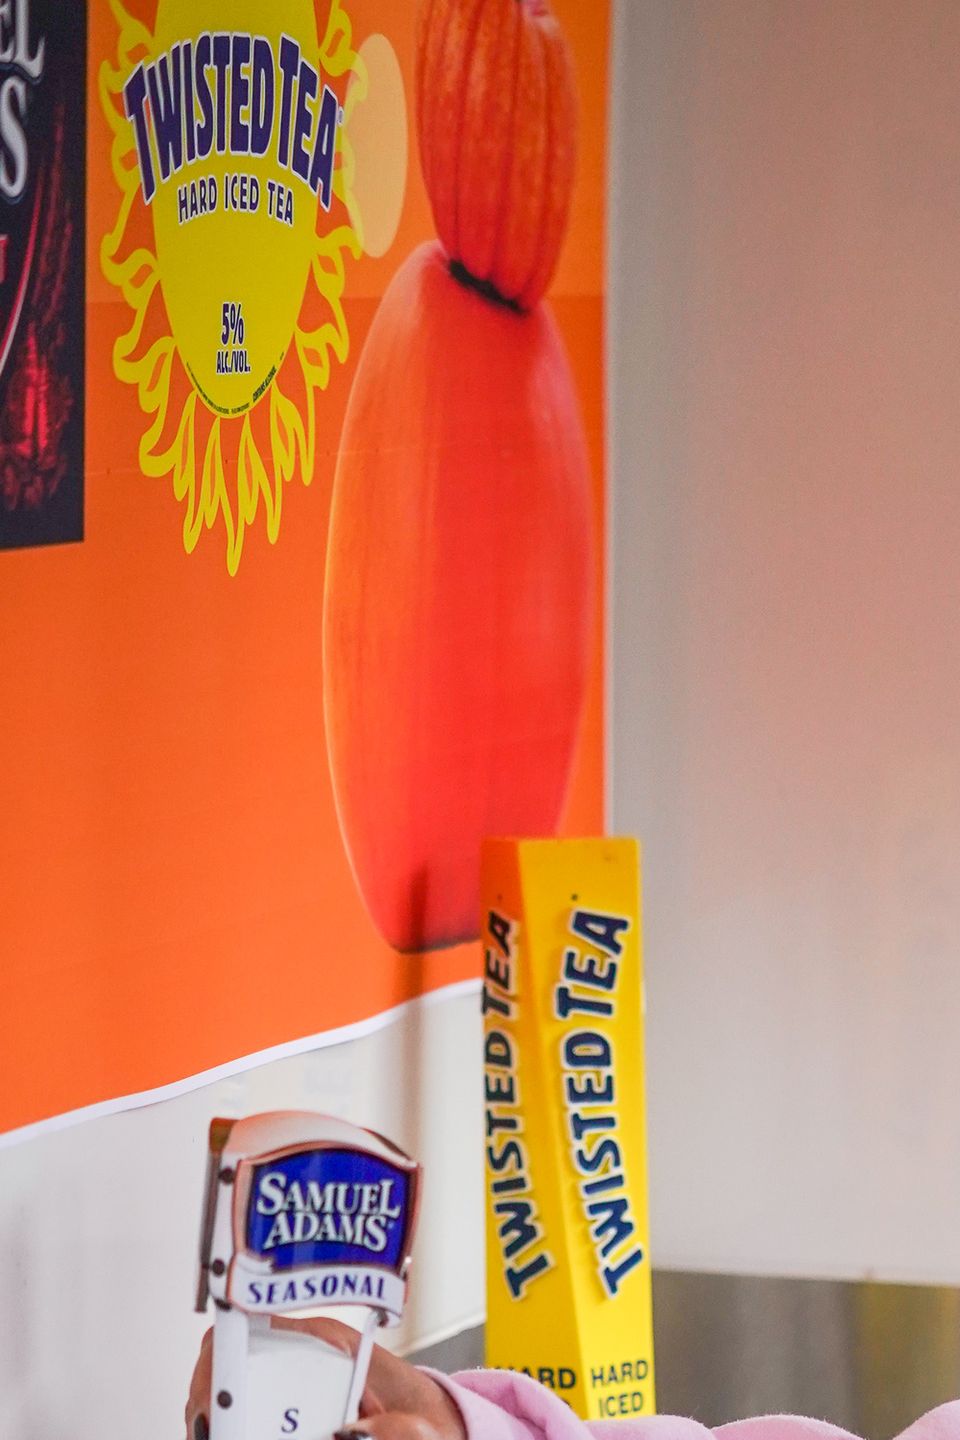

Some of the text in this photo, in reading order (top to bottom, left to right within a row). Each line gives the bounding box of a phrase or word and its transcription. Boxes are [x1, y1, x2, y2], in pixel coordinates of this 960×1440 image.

[123, 32, 275, 204] TWISTED
[277, 32, 338, 212] TEA
[178, 173, 294, 227] HARD ICED TEA
[220, 302, 245, 346] 5%
[215, 349, 251, 374] ALC./VOL.
[481, 909, 552, 1299] TWISTED TEA
[555, 908, 644, 1298] TWISTED TEA
[256, 1172, 401, 1219] SAMUEL
[262, 1211, 388, 1252] ADAMS
[248, 1273, 386, 1305] SEASONAL
[591, 1359, 649, 1389] HARD
[600, 1391, 643, 1419] ICED
